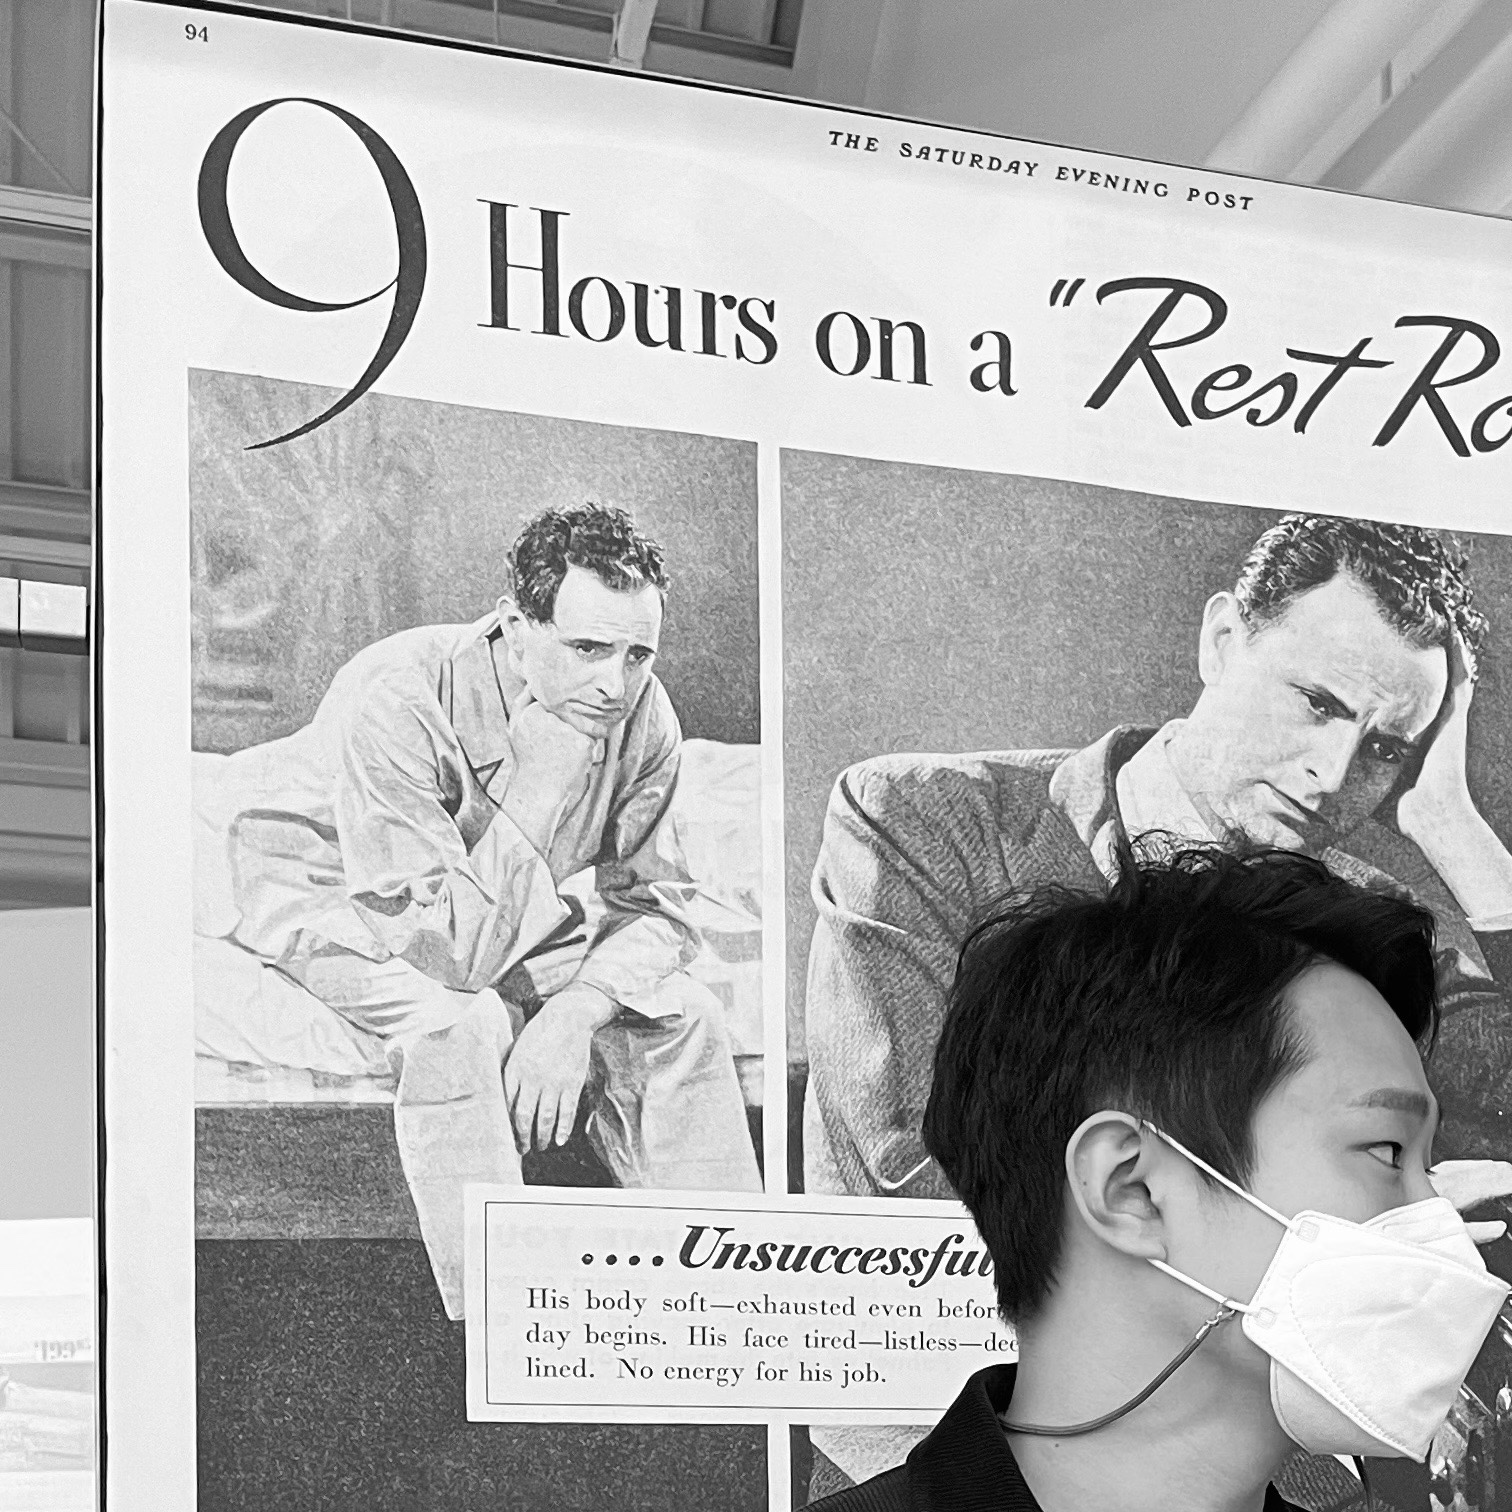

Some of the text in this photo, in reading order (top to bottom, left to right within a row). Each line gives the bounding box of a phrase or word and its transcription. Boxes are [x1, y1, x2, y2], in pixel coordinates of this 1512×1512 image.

[185, 24, 209, 43] 94
[829, 131, 1253, 210] THE SATURDAY EVENING POST
[197, 97, 427, 450] 9
[477, 199, 777, 364] Hours
[816, 311, 932, 386] on
[970, 331, 1017, 396] a
[527, 1288, 1008, 1320] His body soft—exhausted even befor
[526, 1324, 570, 1350] day
[585, 1324, 666, 1350] begins.
[690, 1325, 726, 1346] His
[744, 1328, 788, 1348] face
[527, 1357, 886, 1388] lined. No energy for his job.
